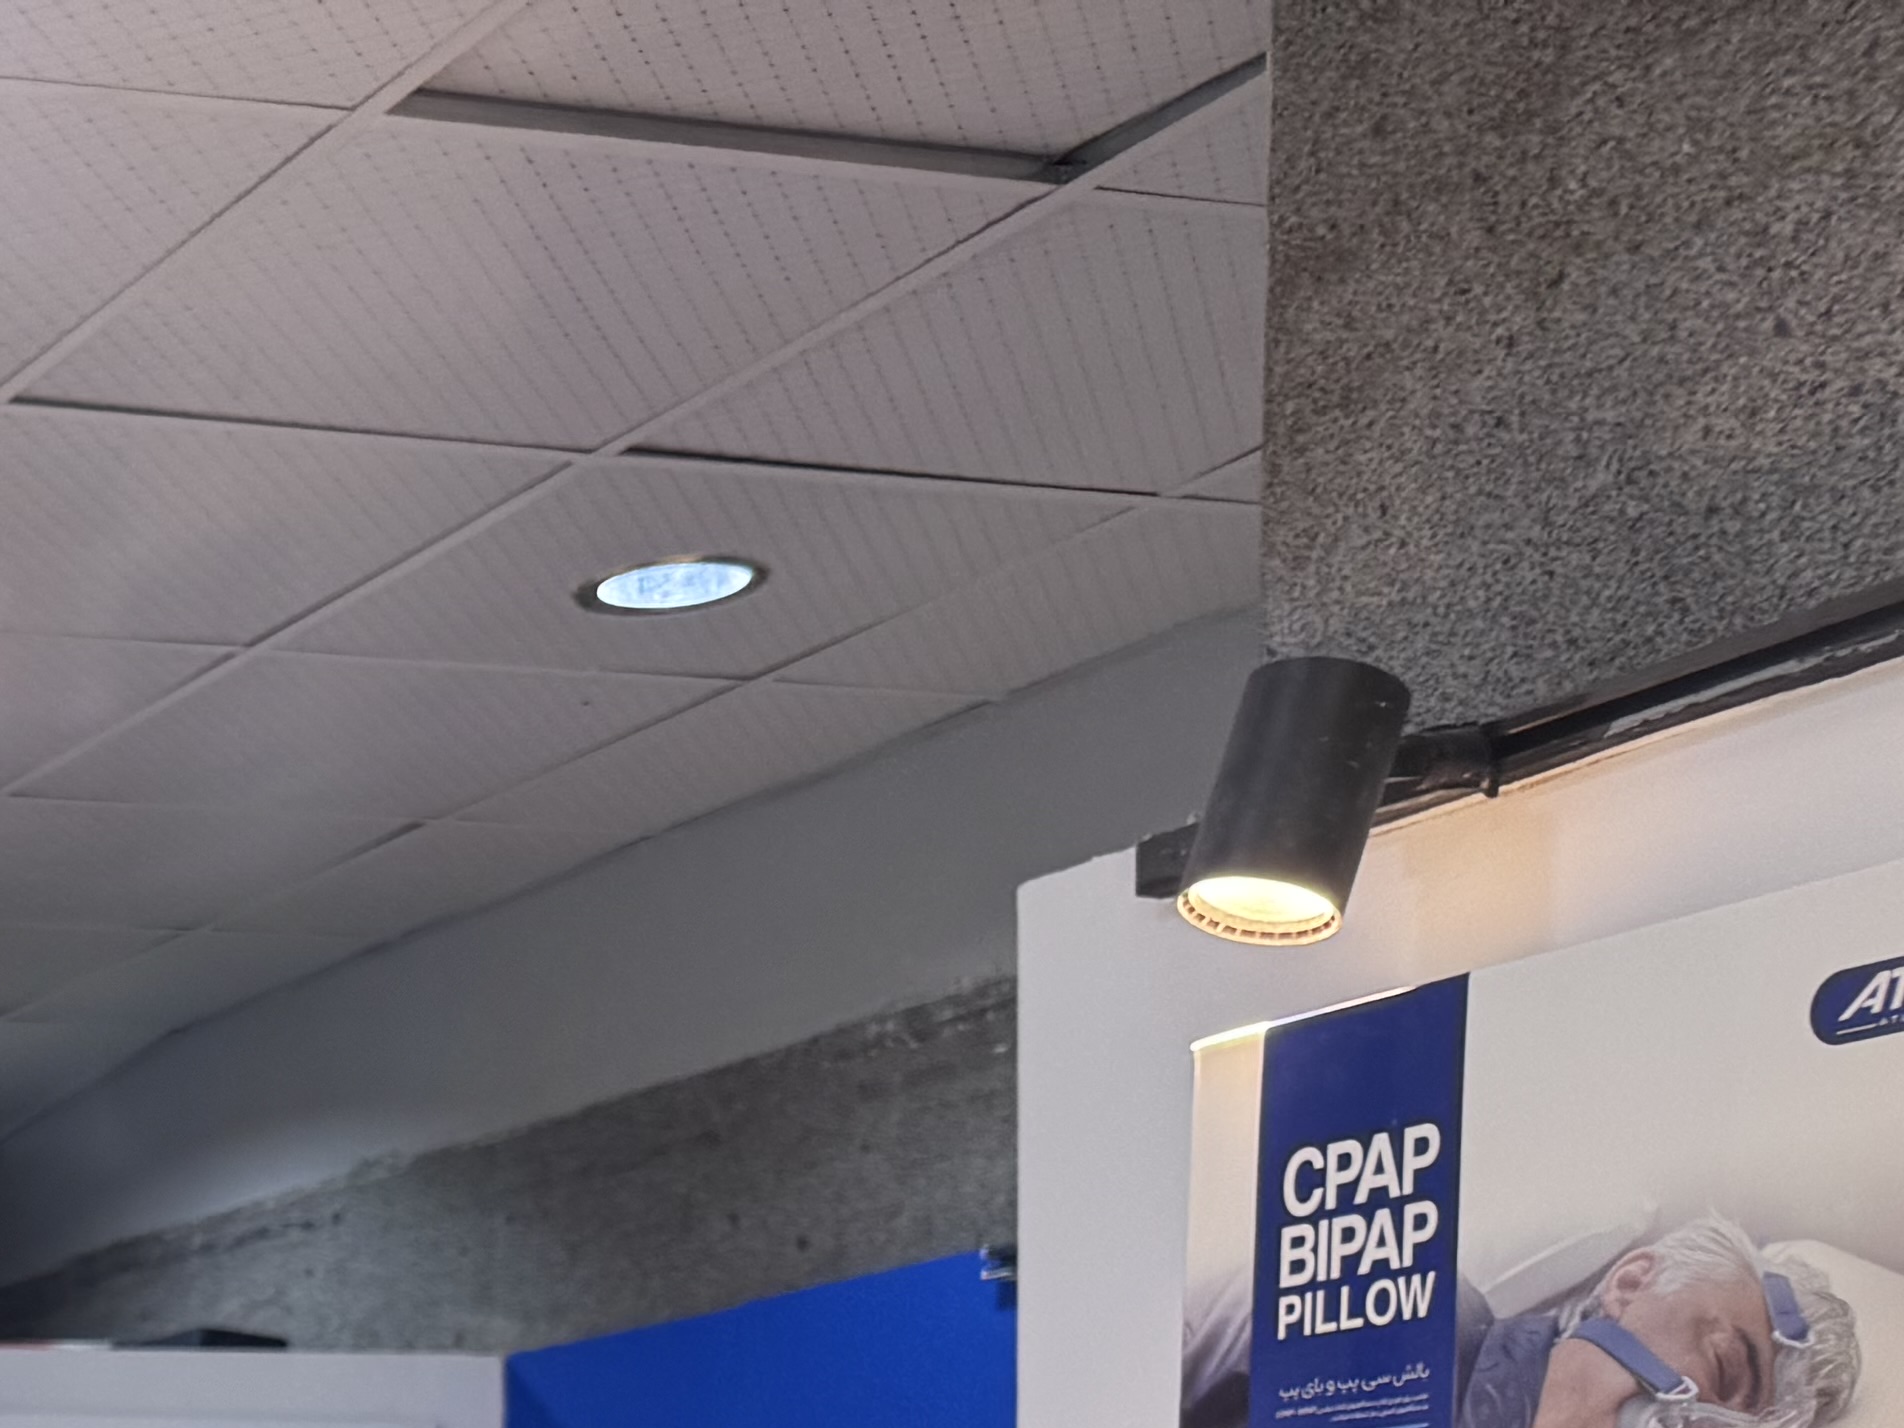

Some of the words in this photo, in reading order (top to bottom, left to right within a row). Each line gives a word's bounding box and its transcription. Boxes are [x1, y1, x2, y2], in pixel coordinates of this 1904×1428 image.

[1283, 1122, 1441, 1218] CPAP
[1278, 1200, 1439, 1289] BIPAP
[1277, 1270, 1436, 1341] PILLOW
[1361, 1374, 1392, 1392] سی
[1392, 1361, 1431, 1387] بالش
[1300, 1377, 1325, 1400] بای
[1325, 1379, 1336, 1396] و
